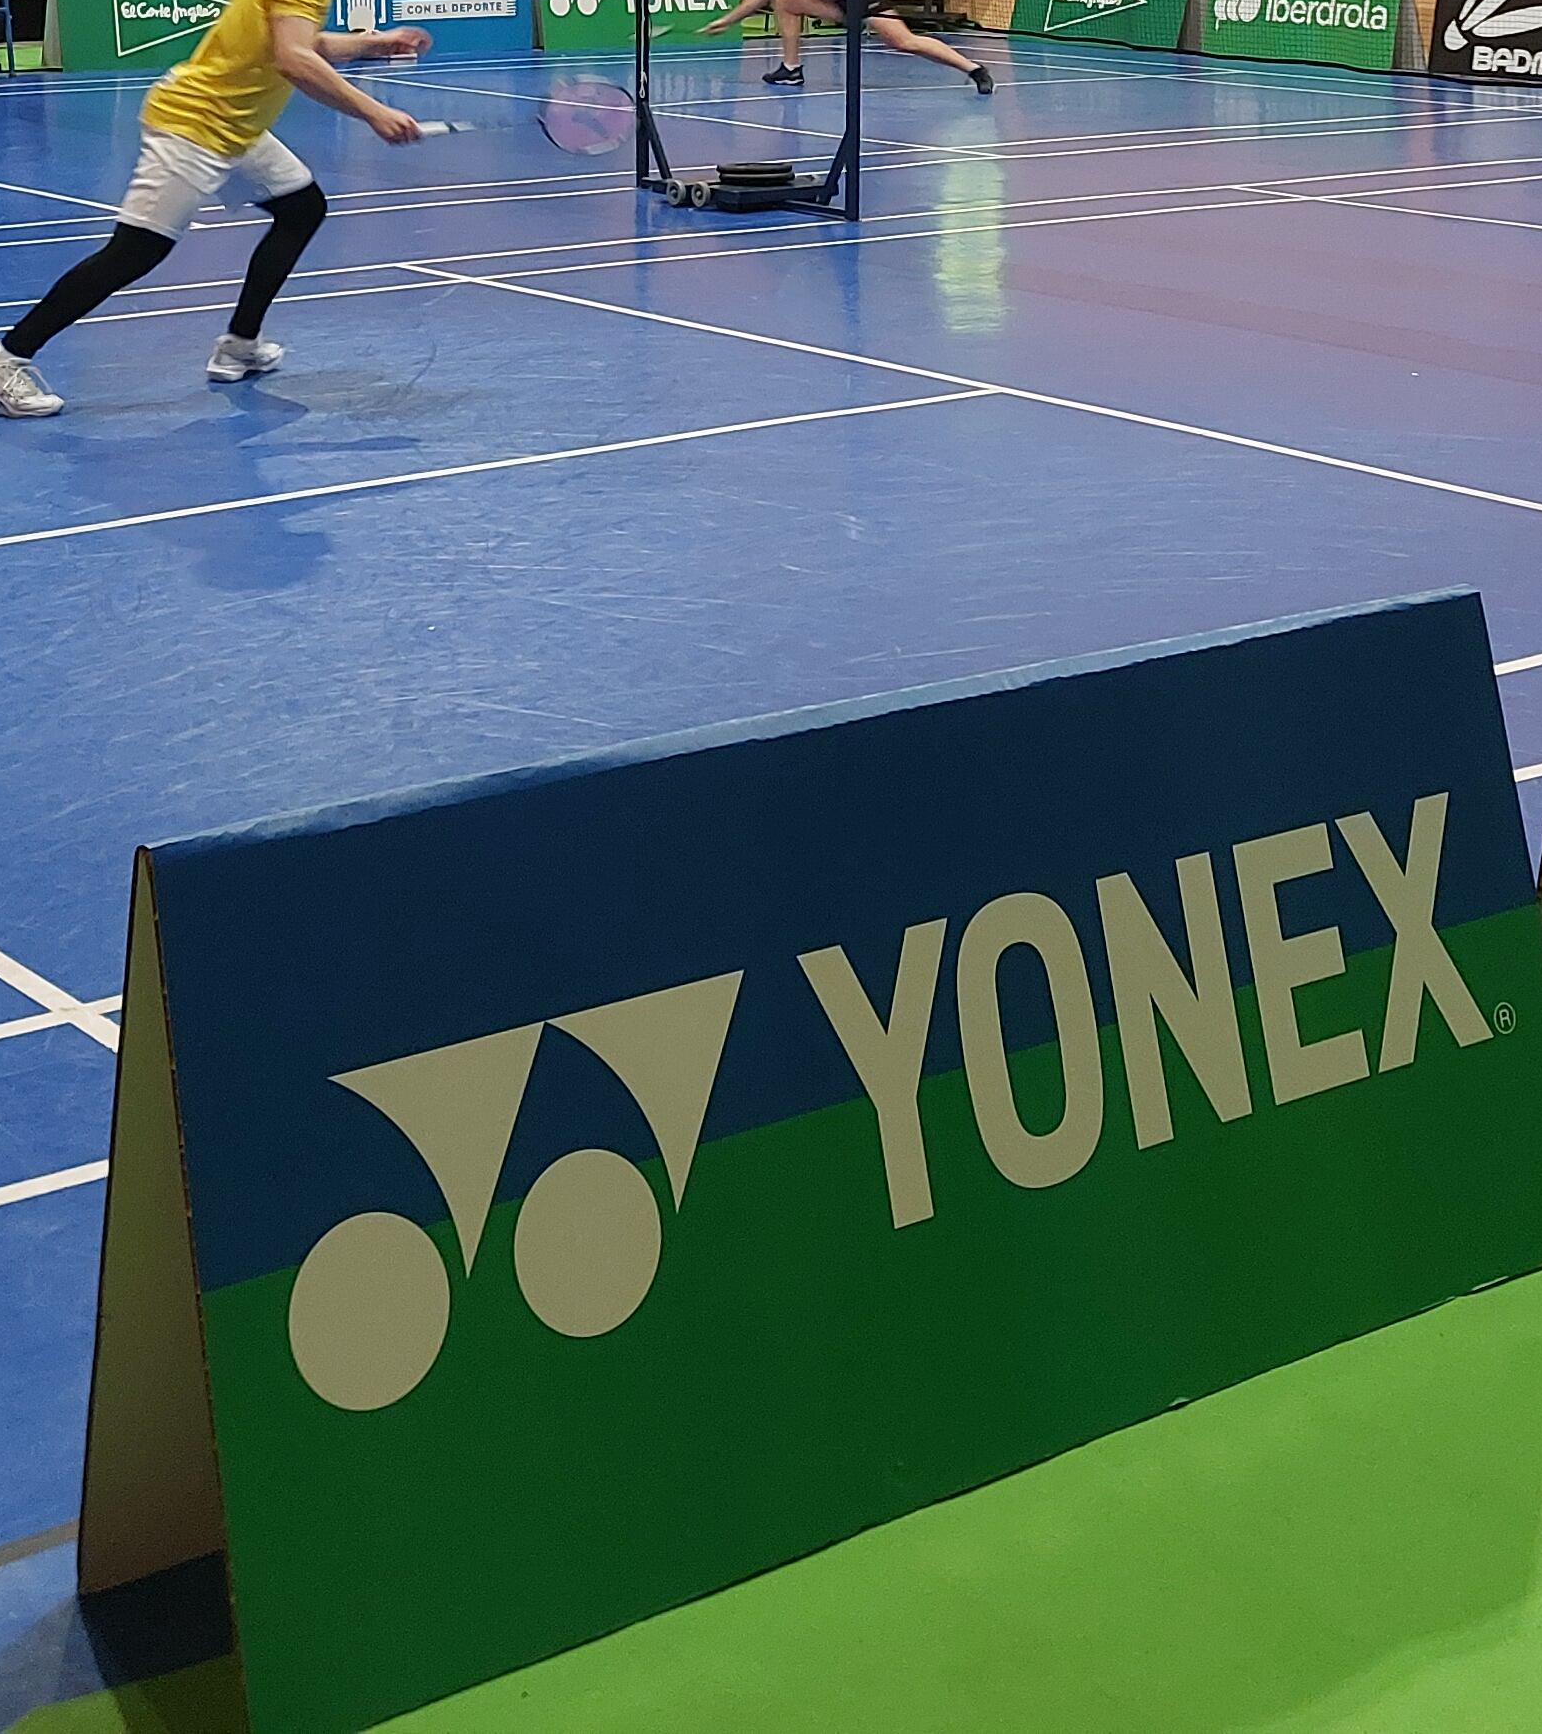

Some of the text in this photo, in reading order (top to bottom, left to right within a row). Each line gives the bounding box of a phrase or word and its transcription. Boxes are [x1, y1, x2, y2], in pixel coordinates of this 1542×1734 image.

[121, 1, 136, 19] El
[136, 2, 171, 19] Corte
[407, 1, 502, 15] CON EL DEPORTE
[796, 791, 1494, 1229] YONEX
